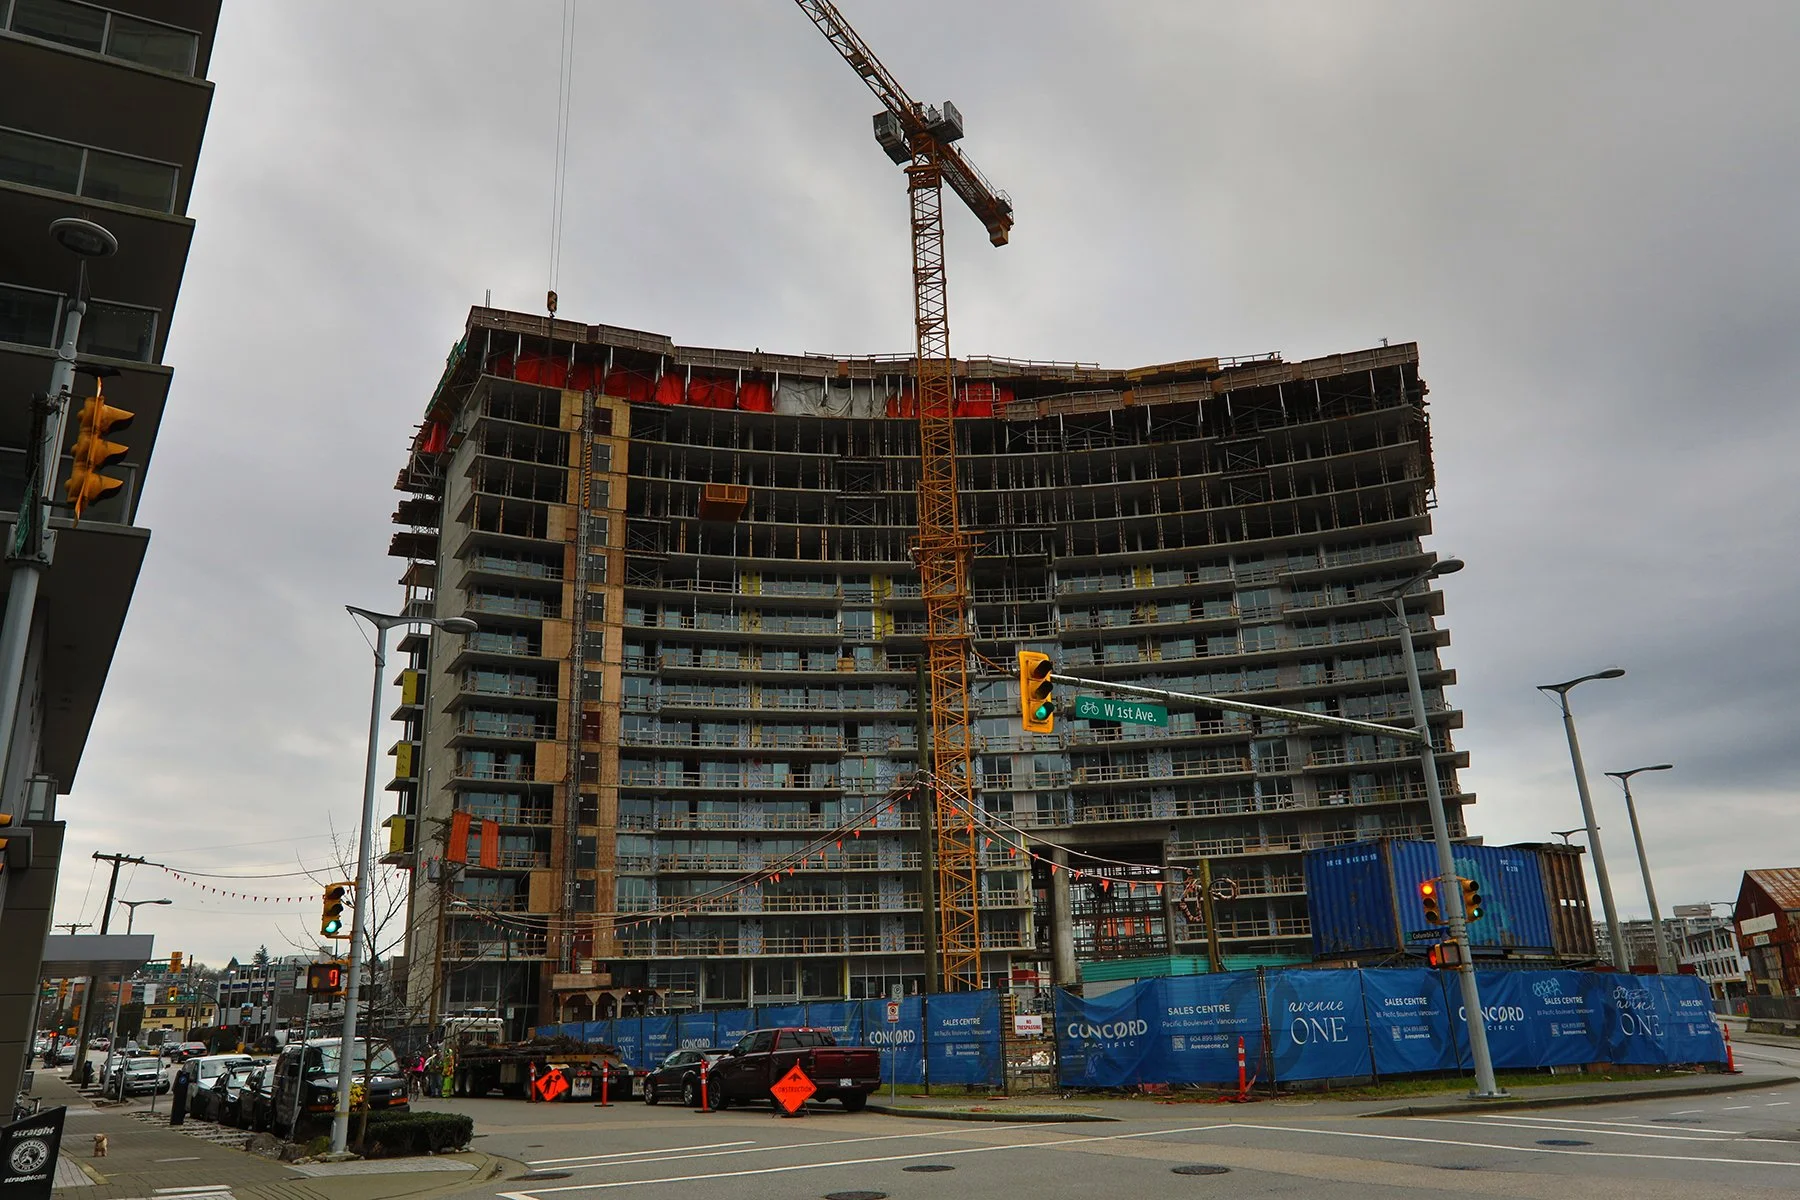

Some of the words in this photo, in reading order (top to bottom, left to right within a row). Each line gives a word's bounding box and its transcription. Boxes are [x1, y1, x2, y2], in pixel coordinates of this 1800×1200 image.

[1104, 704, 1114, 716] W
[1117, 707, 1133, 719] 1st
[1135, 708, 1156, 722] Ave.
[1288, 1000, 1344, 1012] avenue
[1384, 998, 1403, 1006] SALES
[1404, 997, 1428, 1005] CENTRE
[1562, 996, 1583, 1004] CENTRE
[1168, 1006, 1194, 1016] SALES
[1196, 1004, 1230, 1014] CENTRE
[959, 1018, 980, 1026] CENTRE
[1620, 1013, 1664, 1036] ONE
[1290, 1017, 1348, 1044] ONE
[1084, 1041, 1134, 1049] PACIFIC
[620, 1045, 635, 1060] NE
[12, 1126, 54, 1137] straight
